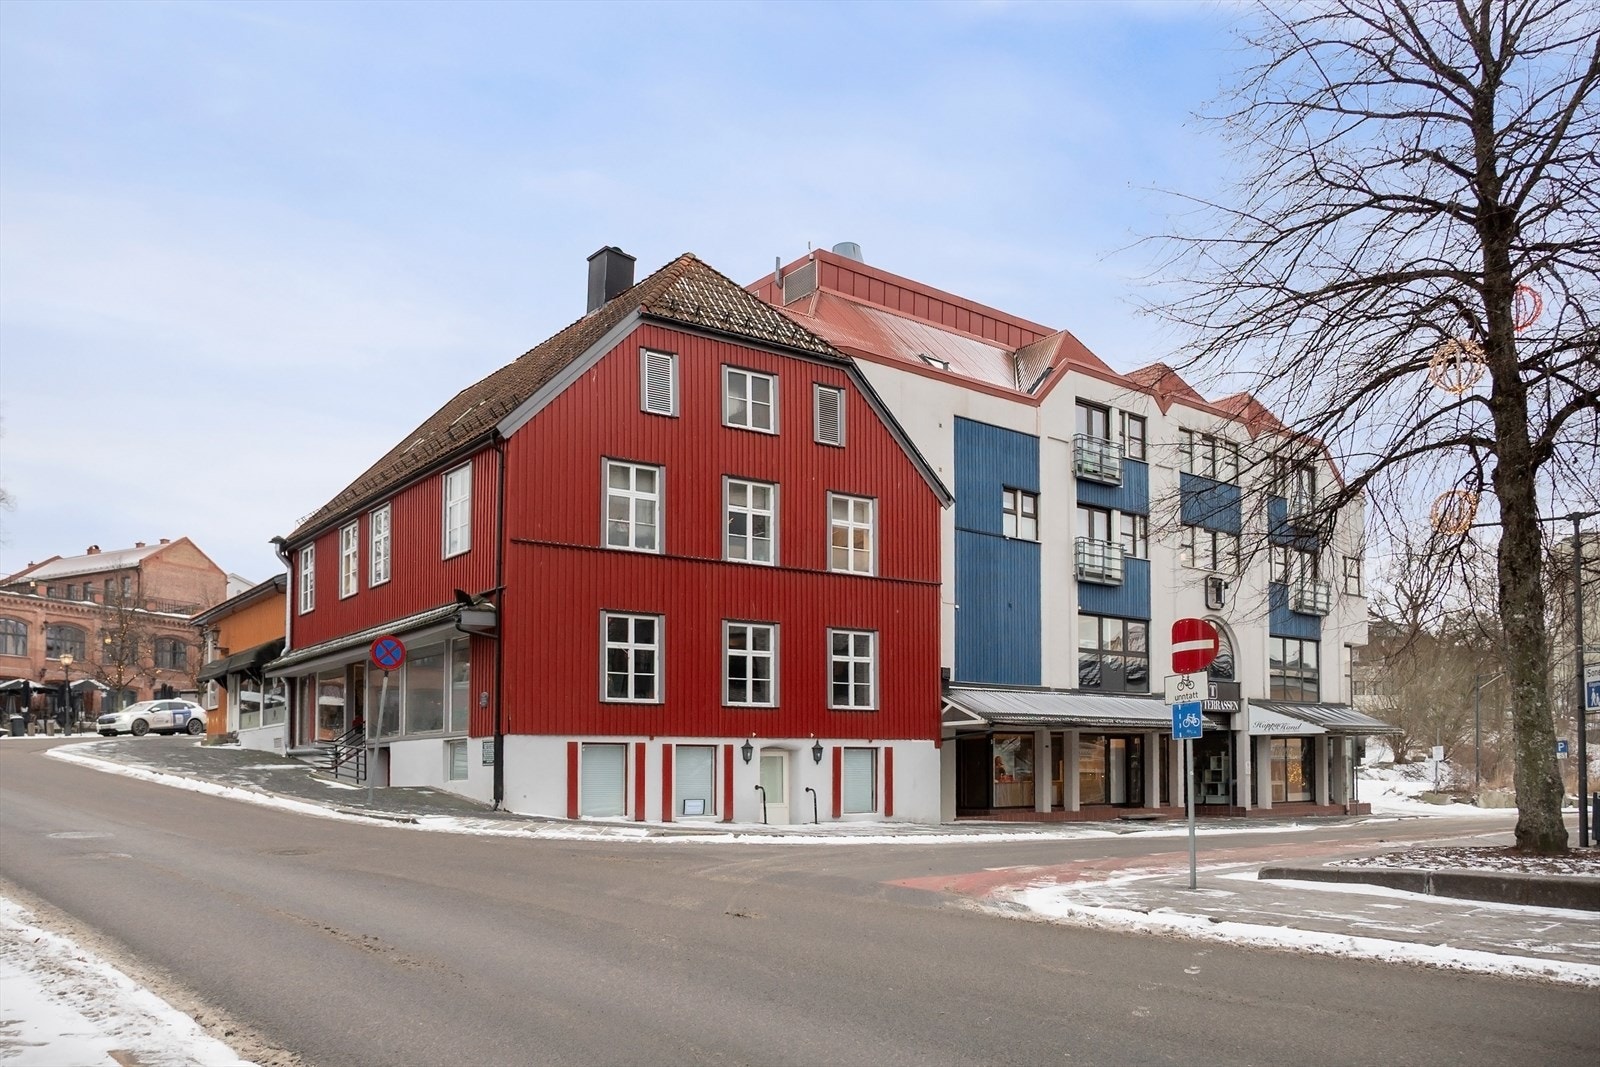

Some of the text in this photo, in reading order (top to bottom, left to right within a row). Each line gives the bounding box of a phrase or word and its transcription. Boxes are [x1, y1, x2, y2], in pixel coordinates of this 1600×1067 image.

[1175, 692, 1199, 701] unntatt
[1204, 700, 1239, 711] TERRASSEN
[1557, 742, 1565, 752] P
